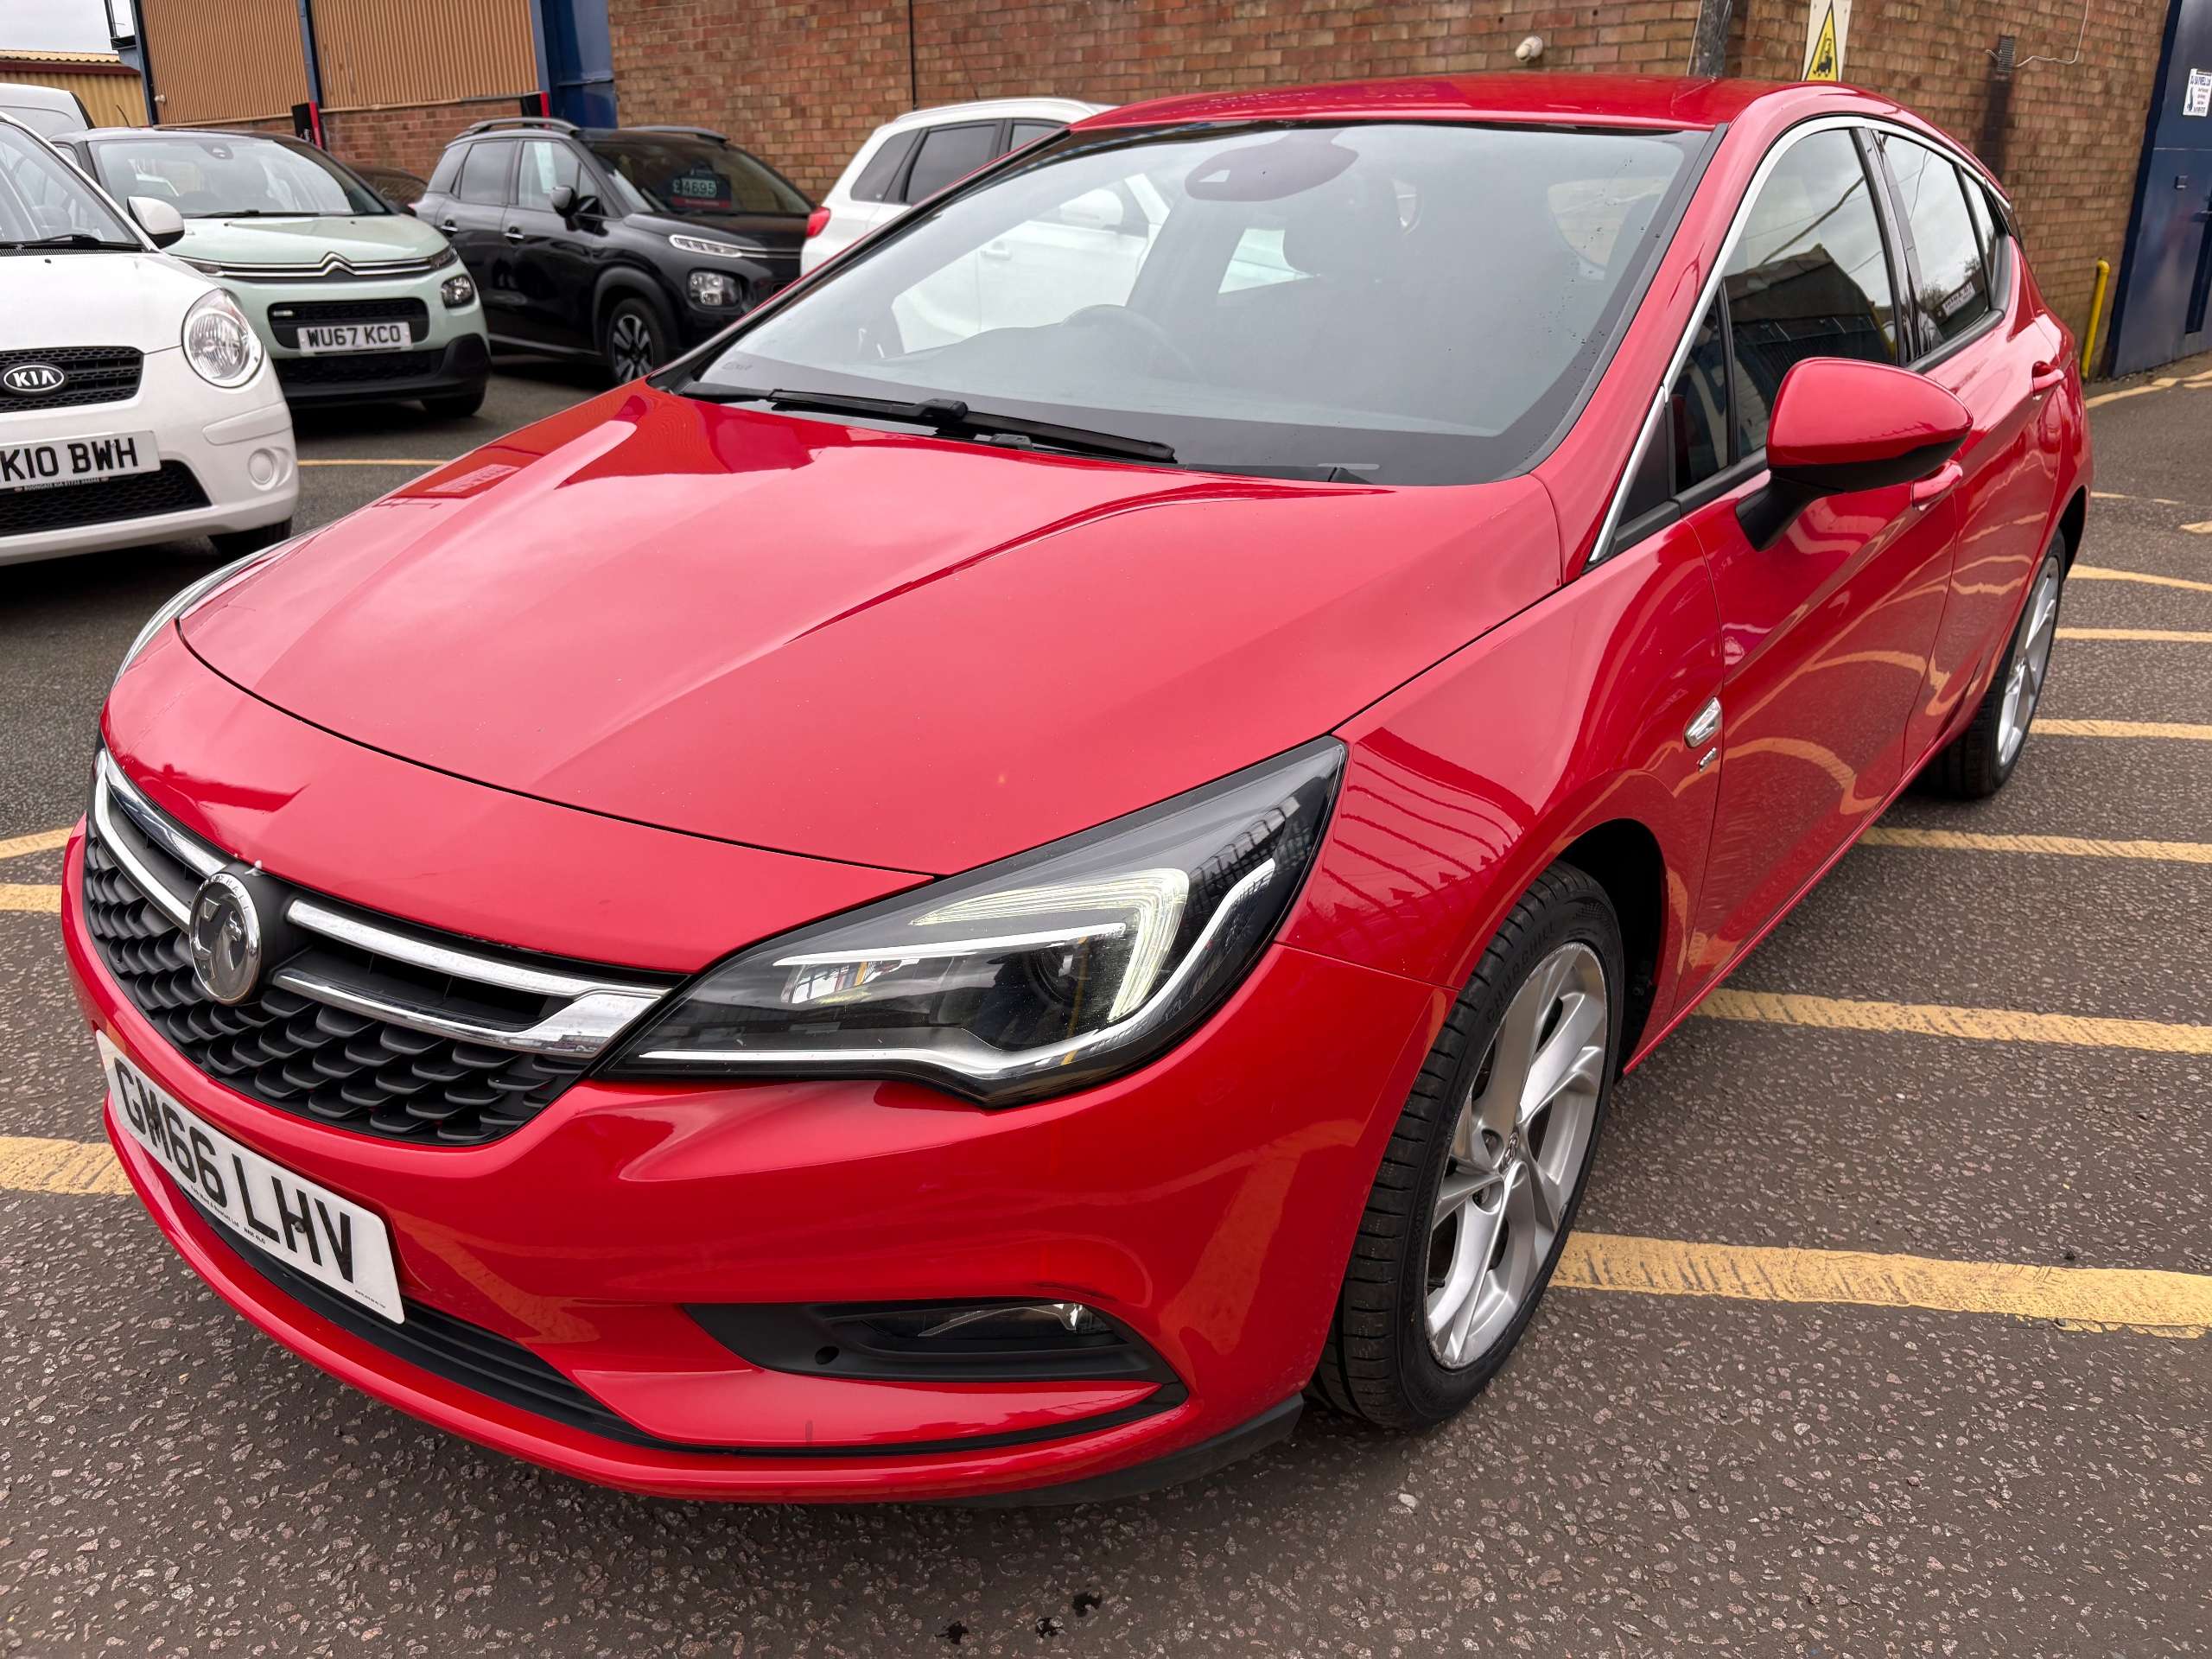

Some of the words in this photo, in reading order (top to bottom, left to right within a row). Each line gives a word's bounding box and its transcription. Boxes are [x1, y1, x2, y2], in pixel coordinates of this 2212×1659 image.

[307, 327, 358, 347] WU67
[364, 325, 401, 344] KCO
[13, 370, 56, 387] KIA
[0, 446, 60, 482] K10
[67, 437, 138, 474] BWH
[114, 1057, 227, 1208] GM66
[232, 1154, 353, 1283] LHV
